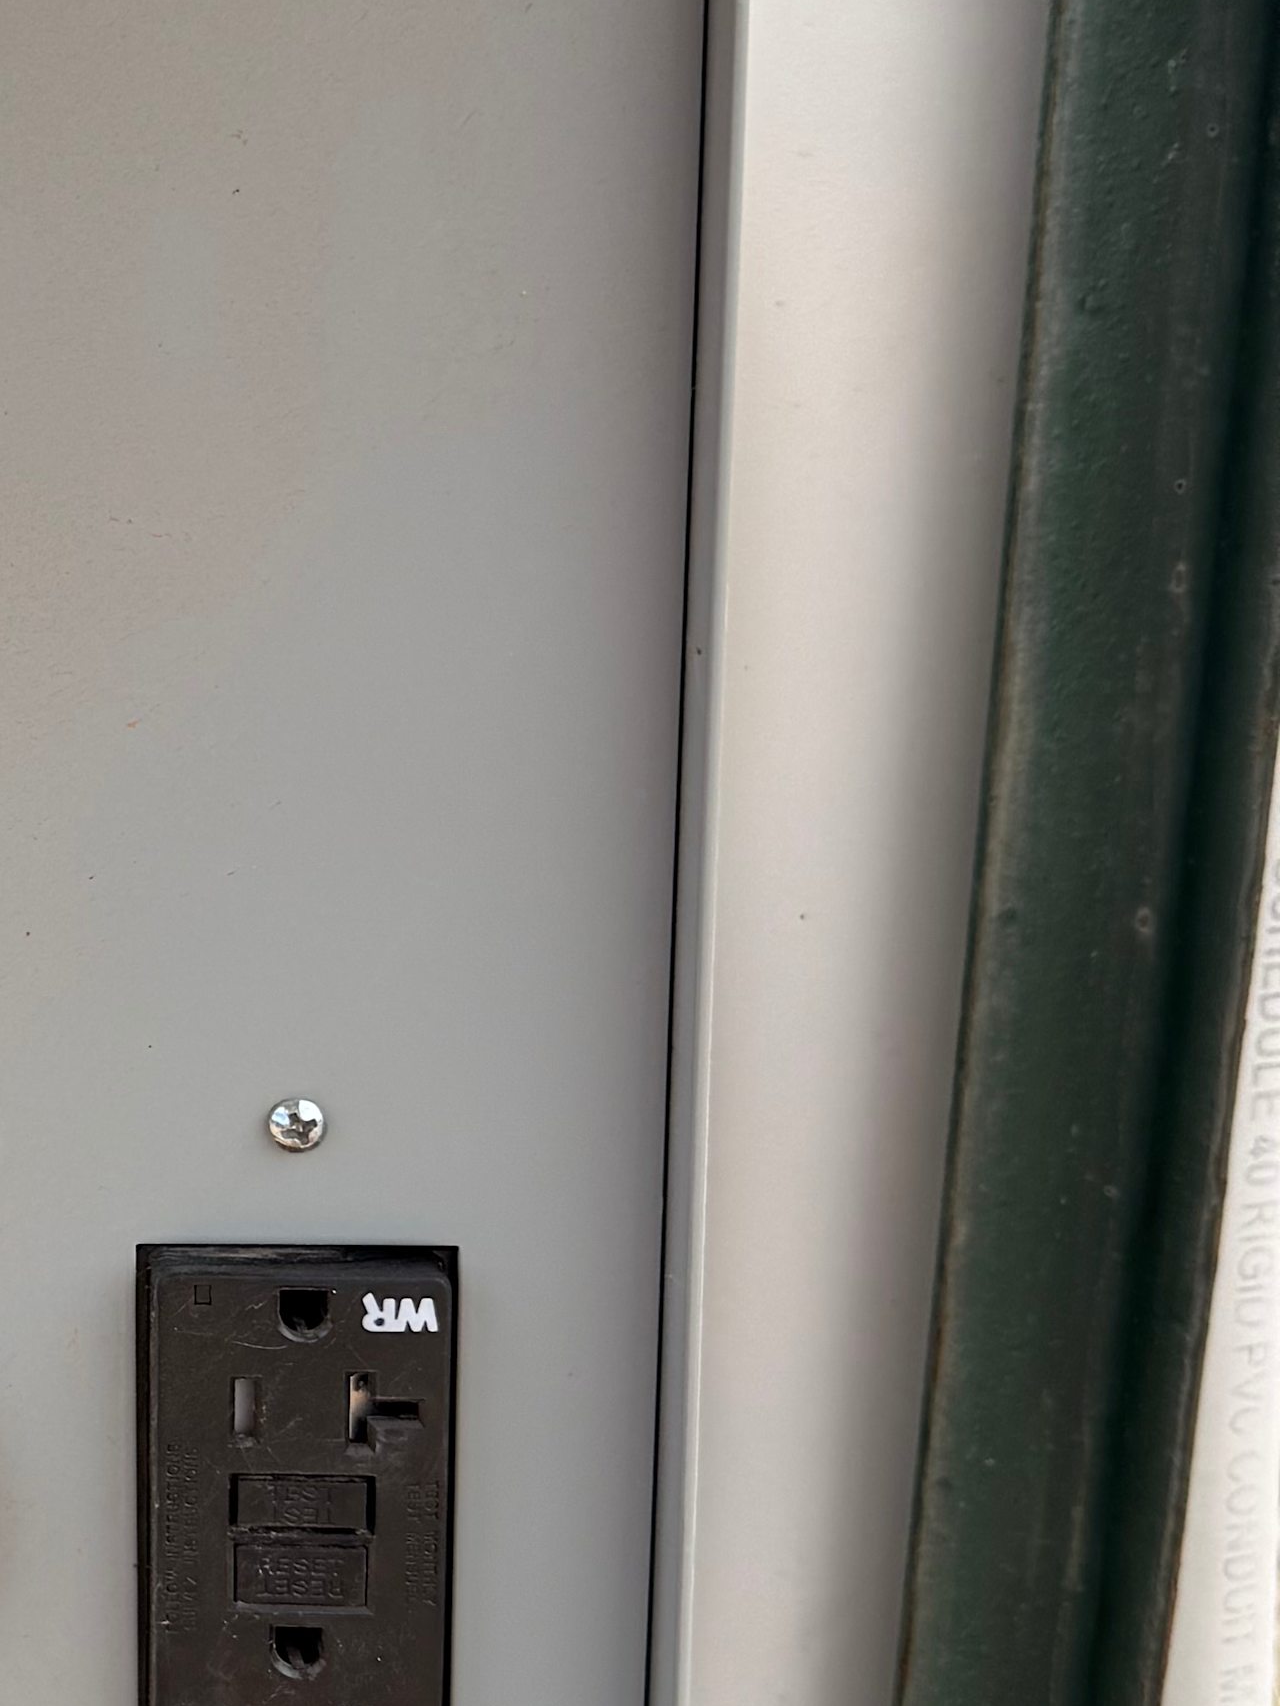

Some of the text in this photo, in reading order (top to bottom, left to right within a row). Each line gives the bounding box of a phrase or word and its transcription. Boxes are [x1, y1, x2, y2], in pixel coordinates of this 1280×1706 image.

[1249, 1135, 1279, 1186] 40
[1233, 1200, 1279, 1331] RIGID
[362, 1291, 438, 1333] WR
[1227, 1342, 1271, 1436] PVC
[256, 1555, 345, 1577] RESET
[1220, 1450, 1262, 1645] CONDUIT
[255, 1579, 345, 1598] RESET
